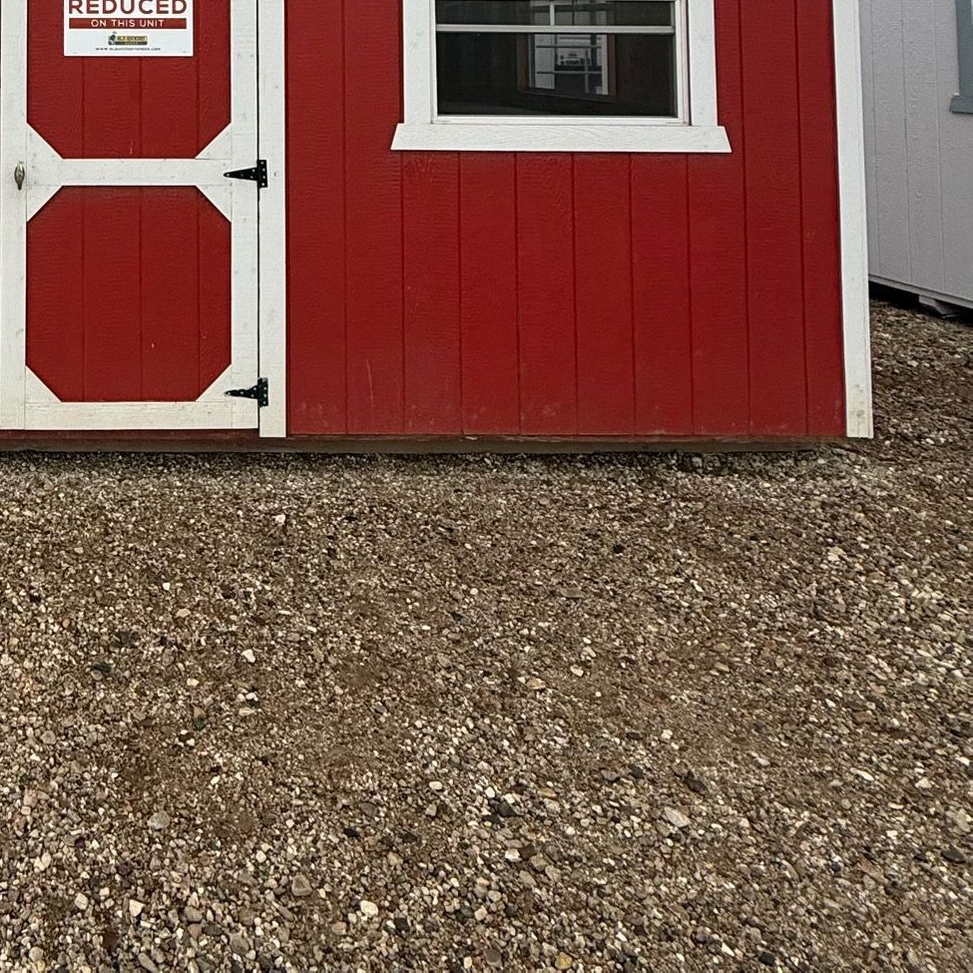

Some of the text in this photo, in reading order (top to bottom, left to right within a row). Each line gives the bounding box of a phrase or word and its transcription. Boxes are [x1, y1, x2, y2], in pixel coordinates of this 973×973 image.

[90, 19, 165, 28] ON THIS UNIT
